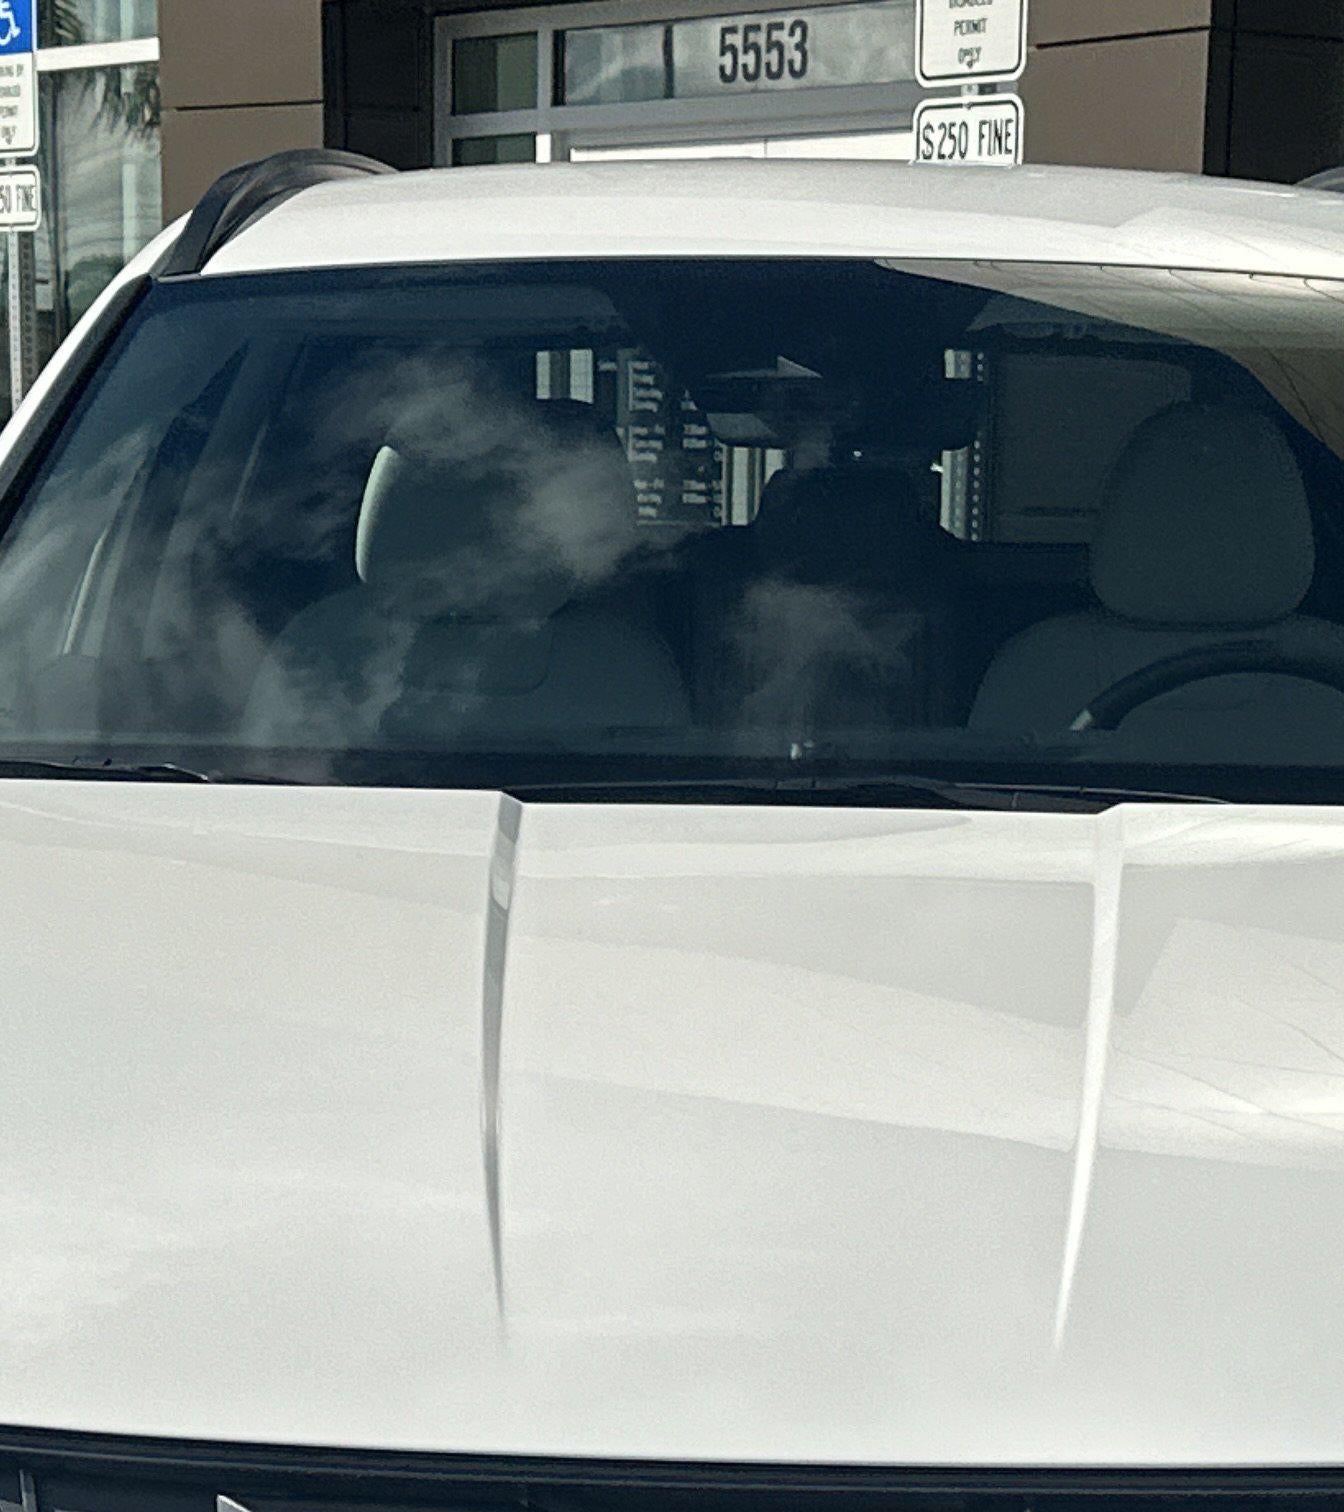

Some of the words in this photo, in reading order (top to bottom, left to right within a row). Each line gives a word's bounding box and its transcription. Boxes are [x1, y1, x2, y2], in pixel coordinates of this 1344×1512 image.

[719, 19, 808, 83] 5553
[921, 120, 969, 160] $250
[977, 118, 1014, 157] FINE
